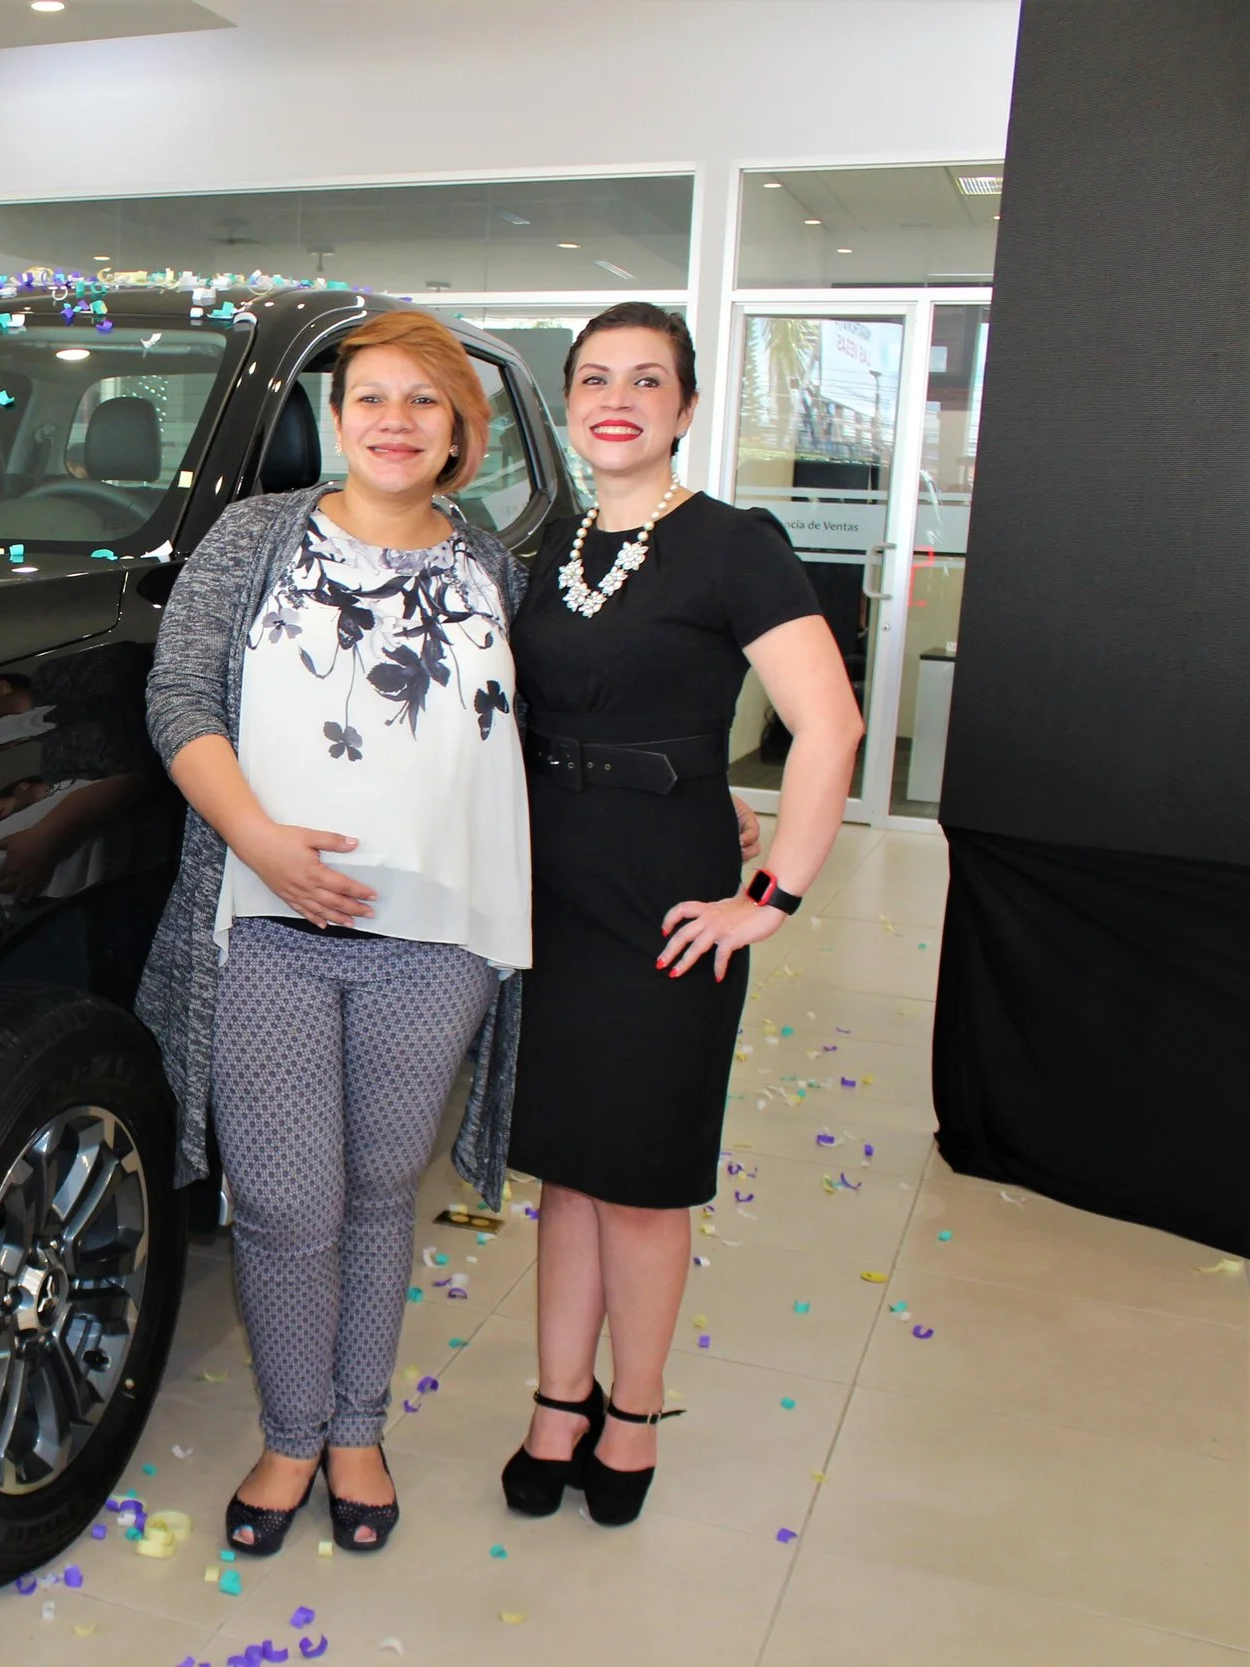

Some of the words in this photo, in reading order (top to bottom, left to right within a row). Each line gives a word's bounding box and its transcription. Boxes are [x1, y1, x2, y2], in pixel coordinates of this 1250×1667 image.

[784, 519, 805, 530] ncia
[808, 520, 821, 530] de
[823, 521, 859, 532] Ventas
